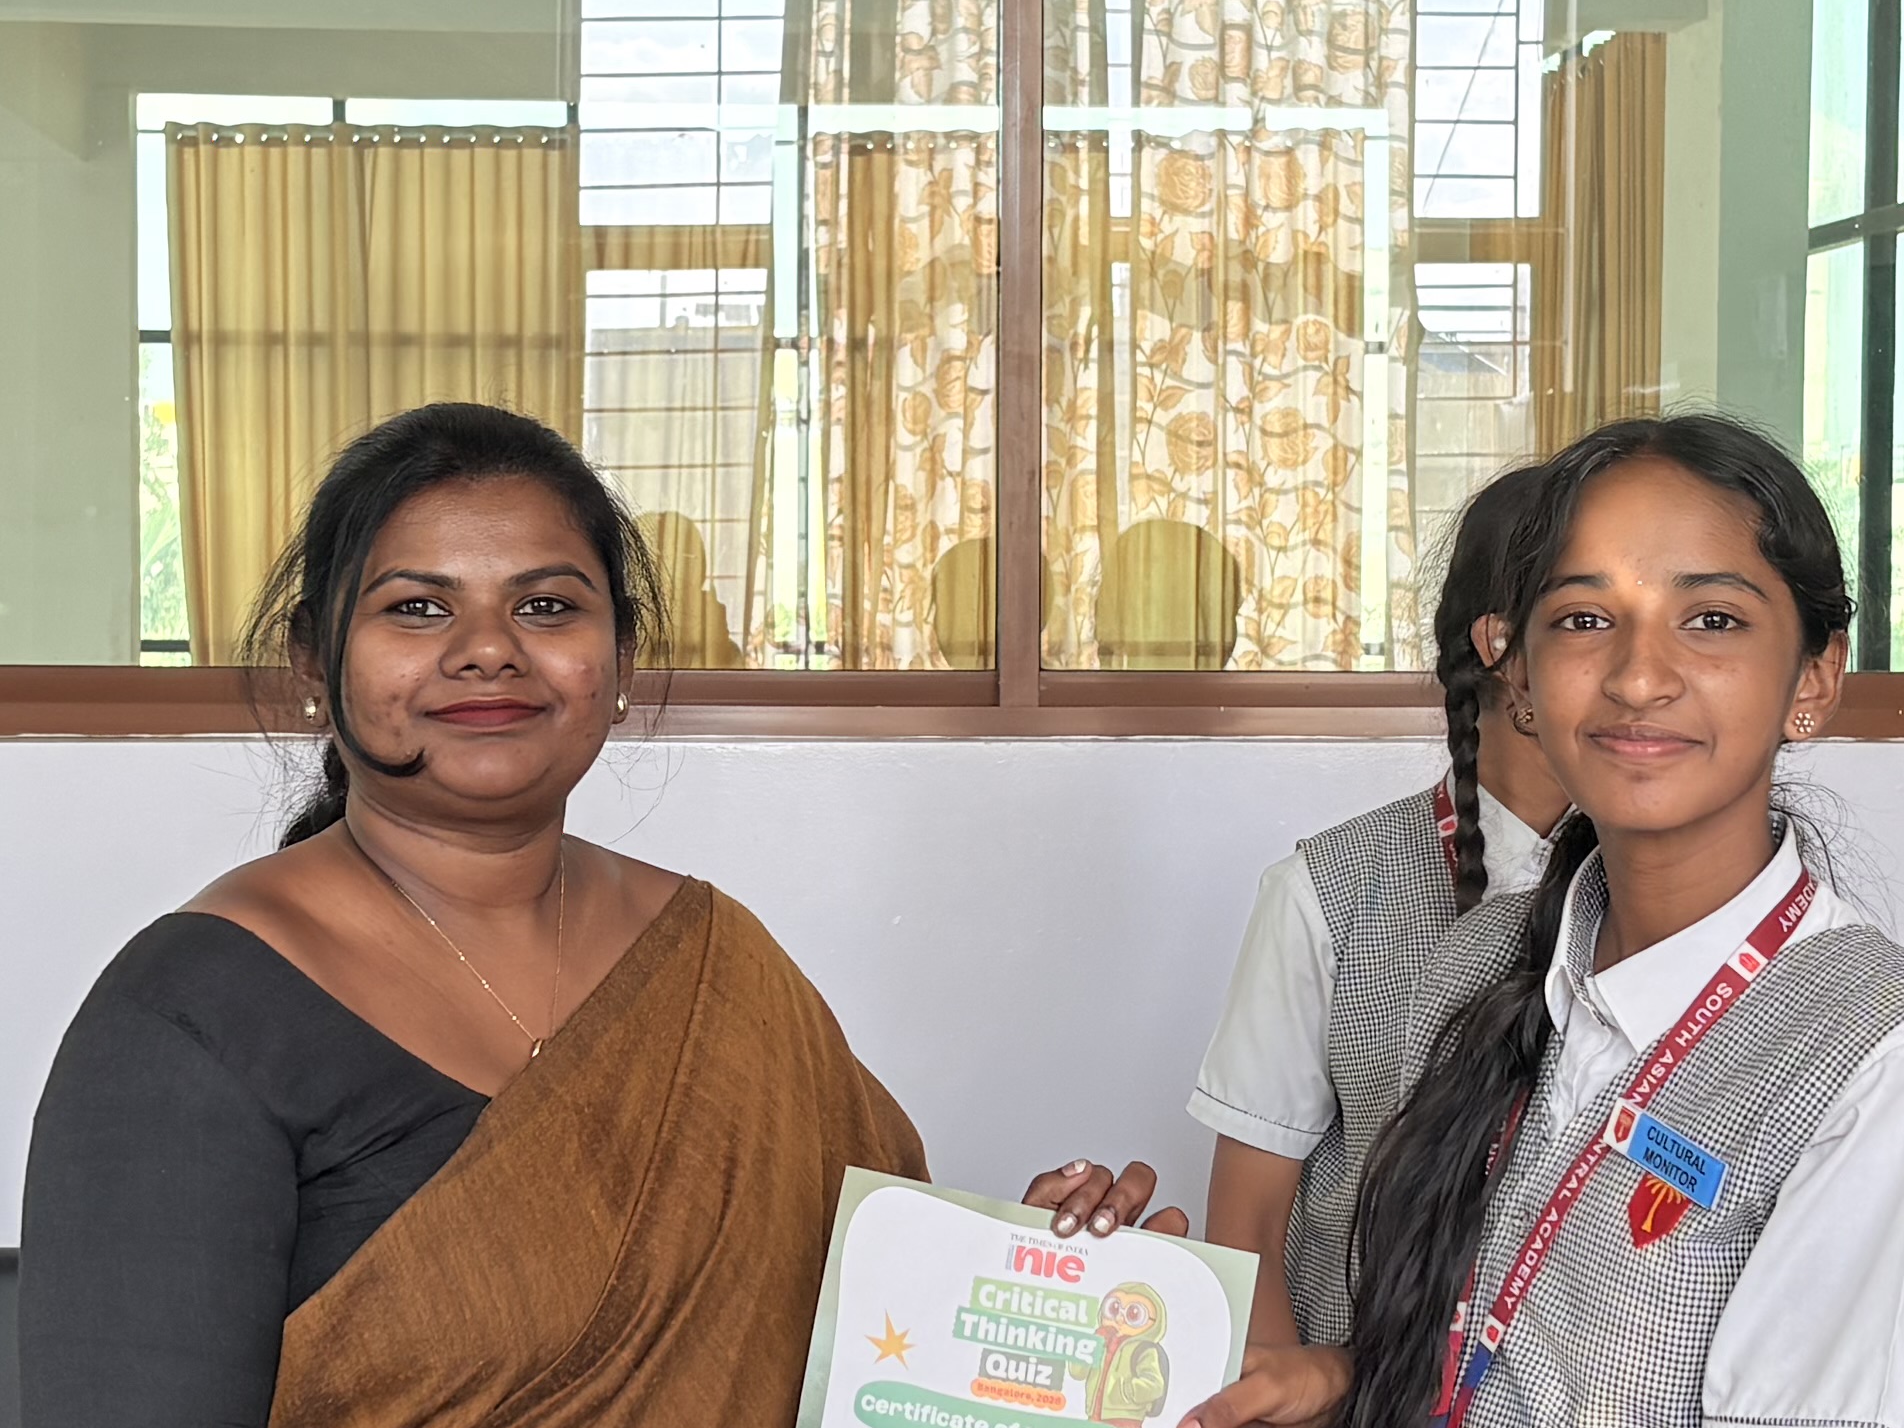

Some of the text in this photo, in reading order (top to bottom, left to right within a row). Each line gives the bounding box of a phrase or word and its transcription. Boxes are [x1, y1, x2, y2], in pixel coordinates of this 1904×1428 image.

[1778, 881, 1817, 932] DEMY
[1627, 982, 1733, 1105] SOUTH ASIAN
[1642, 1148, 1698, 1194] MONITOR
[1647, 1126, 1707, 1176] CULTURAL
[1503, 1138, 1607, 1310] NTRAL ACADEMY
[978, 1283, 1089, 1323] Critical
[960, 1312, 1097, 1365] Thinking
[985, 1353, 1053, 1386] Quiz
